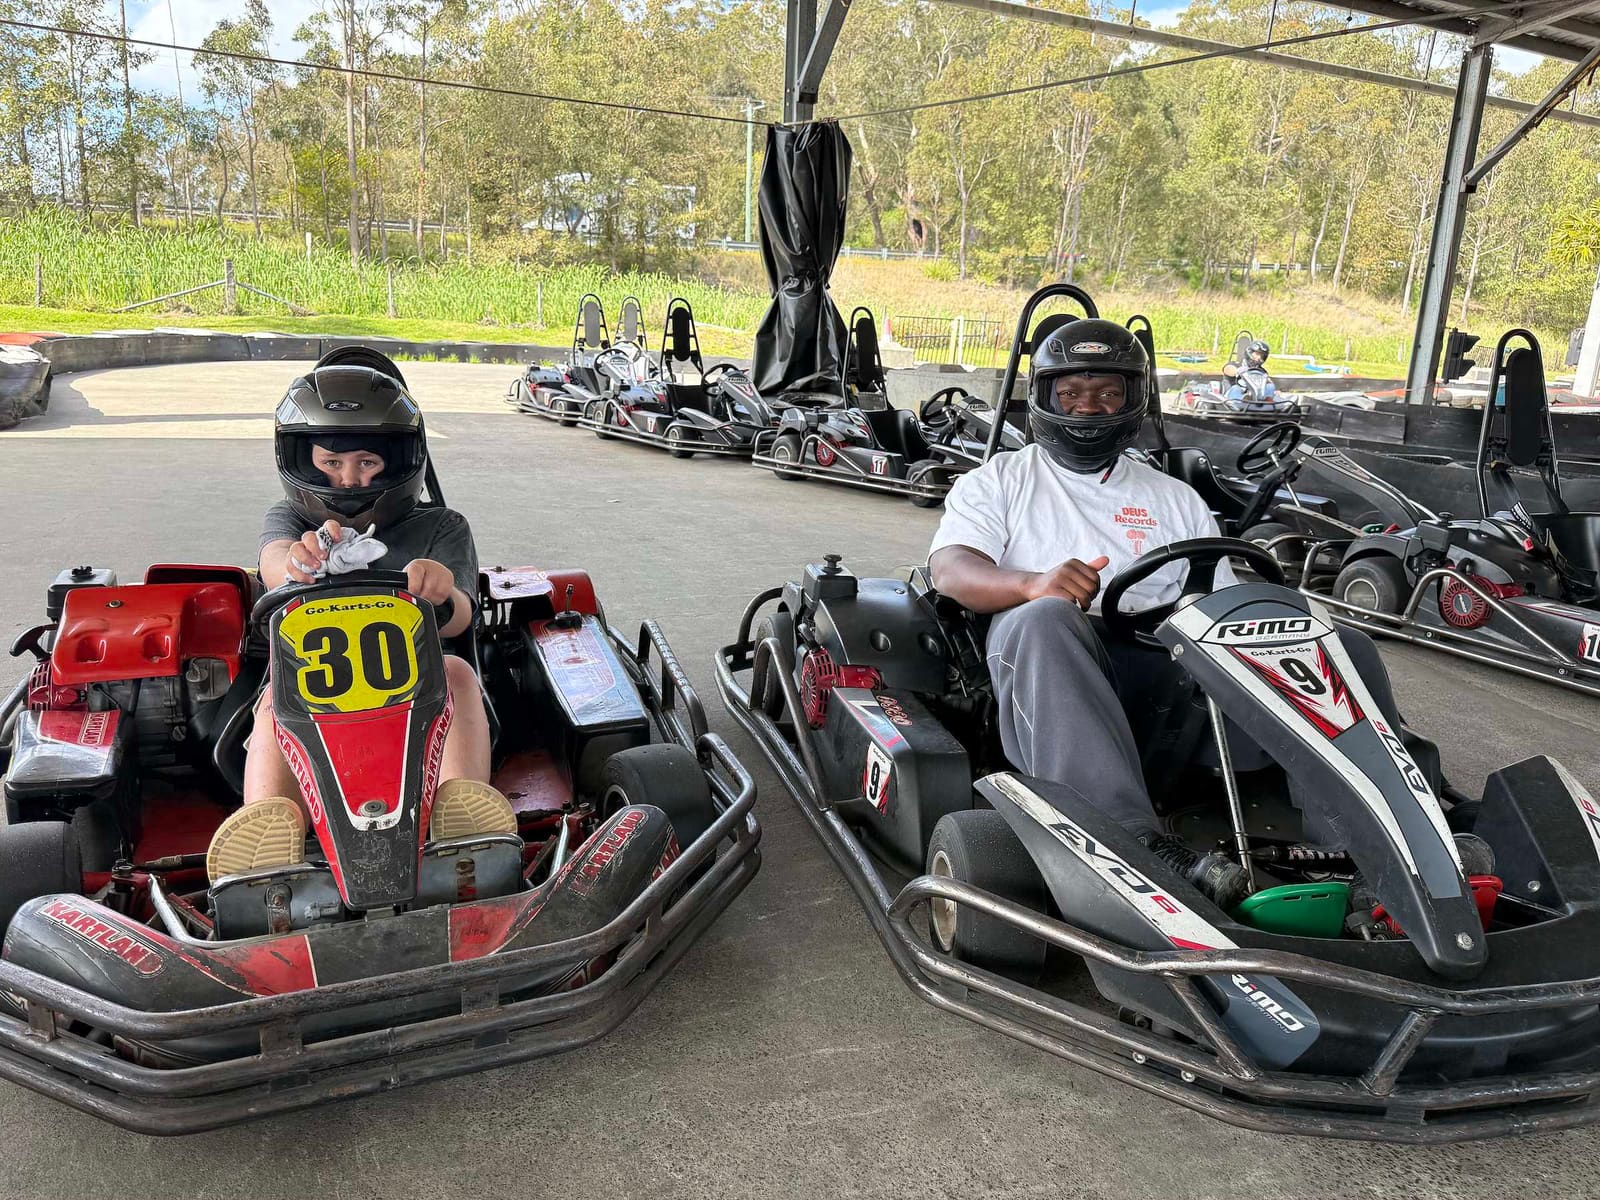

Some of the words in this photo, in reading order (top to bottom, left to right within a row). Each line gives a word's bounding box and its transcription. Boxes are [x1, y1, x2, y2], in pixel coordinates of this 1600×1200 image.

[874, 460, 883, 473] 11
[1114, 514, 1157, 526] Records
[1122, 507, 1147, 517] DEUS
[305, 601, 395, 616] Go-Karts-Go
[1255, 633, 1310, 641] GERMANY
[1587, 633, 1600, 660] 1
[302, 621, 411, 699] 30
[1251, 647, 1312, 657] Go-Karts-Go
[1279, 657, 1327, 696] 9
[423, 706, 453, 806] KARTLAND
[276, 728, 321, 824] KARTLAND
[869, 761, 880, 801] 9
[44, 901, 164, 975] KARTLAND
